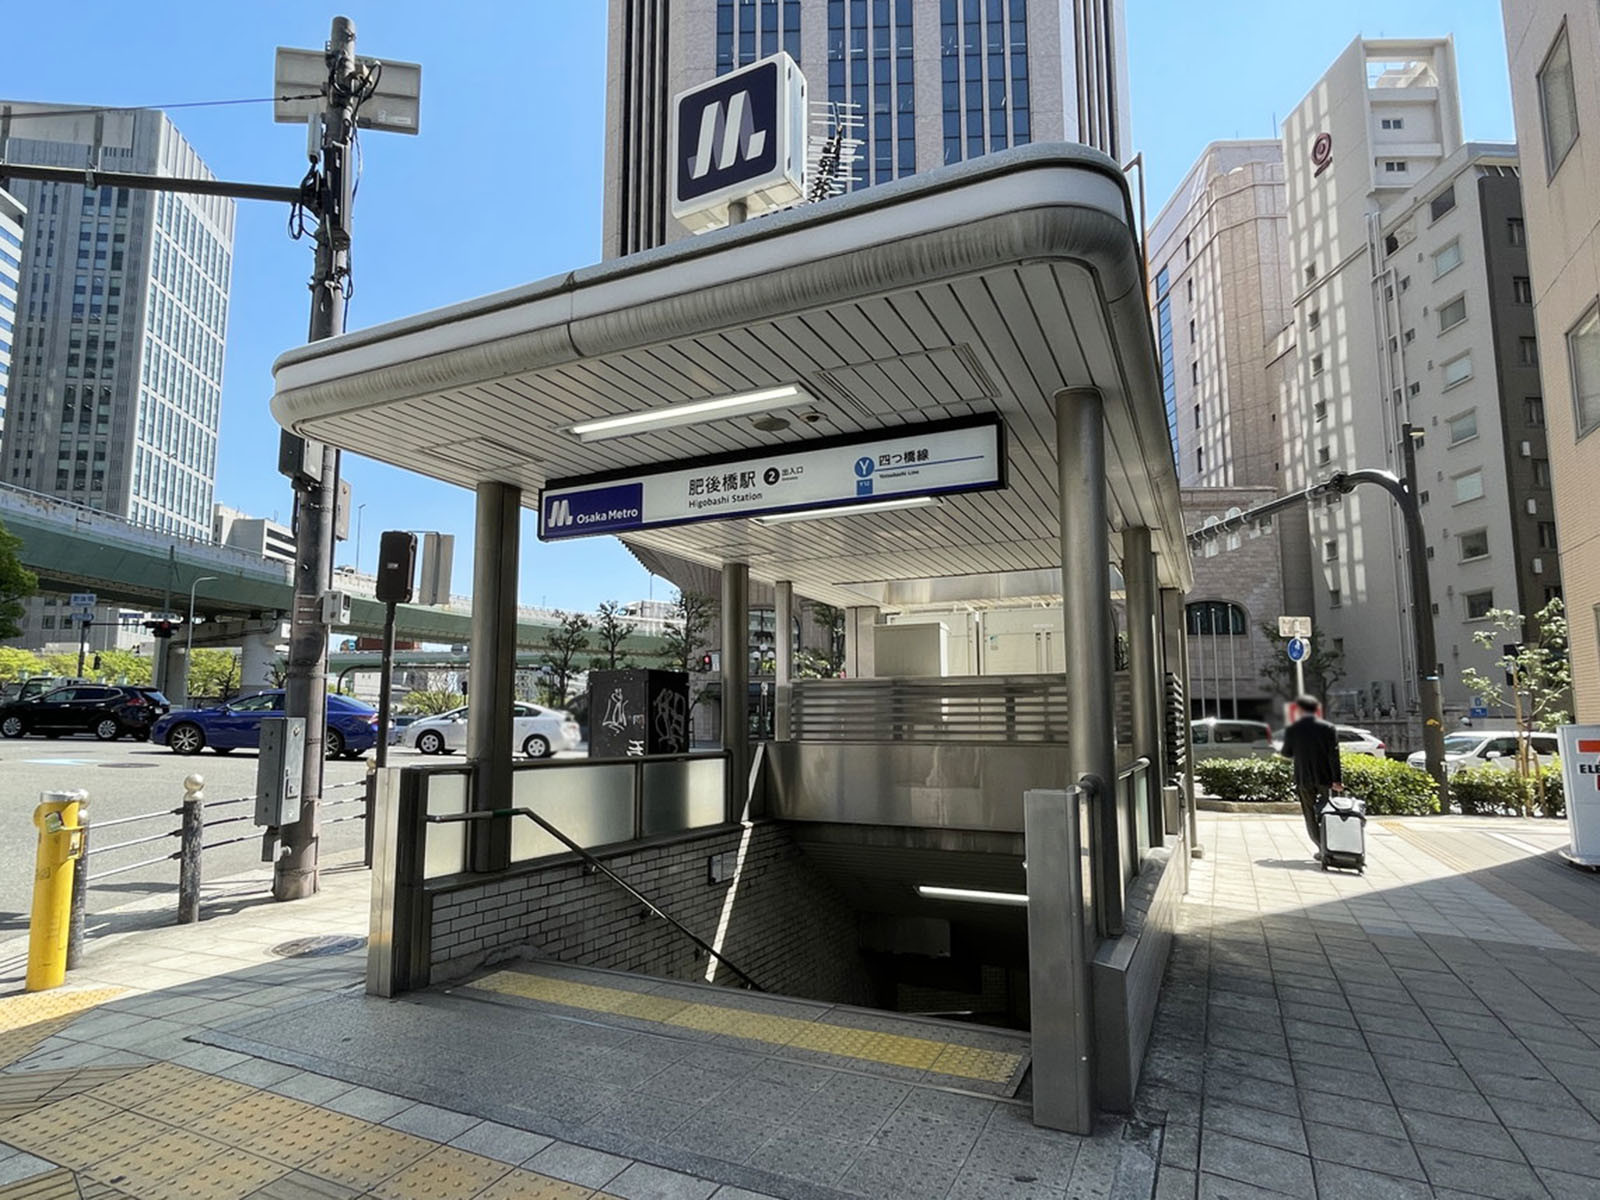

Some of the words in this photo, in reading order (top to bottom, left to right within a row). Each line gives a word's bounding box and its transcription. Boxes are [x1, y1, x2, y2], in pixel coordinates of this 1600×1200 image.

[879, 448, 929, 466] 四つ橋線
[858, 459, 870, 475] Y
[689, 471, 756, 496] 肥後橋駅
[781, 466, 804, 476] 出入口
[688, 494, 730, 509] Higobashi
[731, 491, 763, 503] Station
[576, 513, 607, 524] Osaka
[608, 508, 639, 520] Metro
